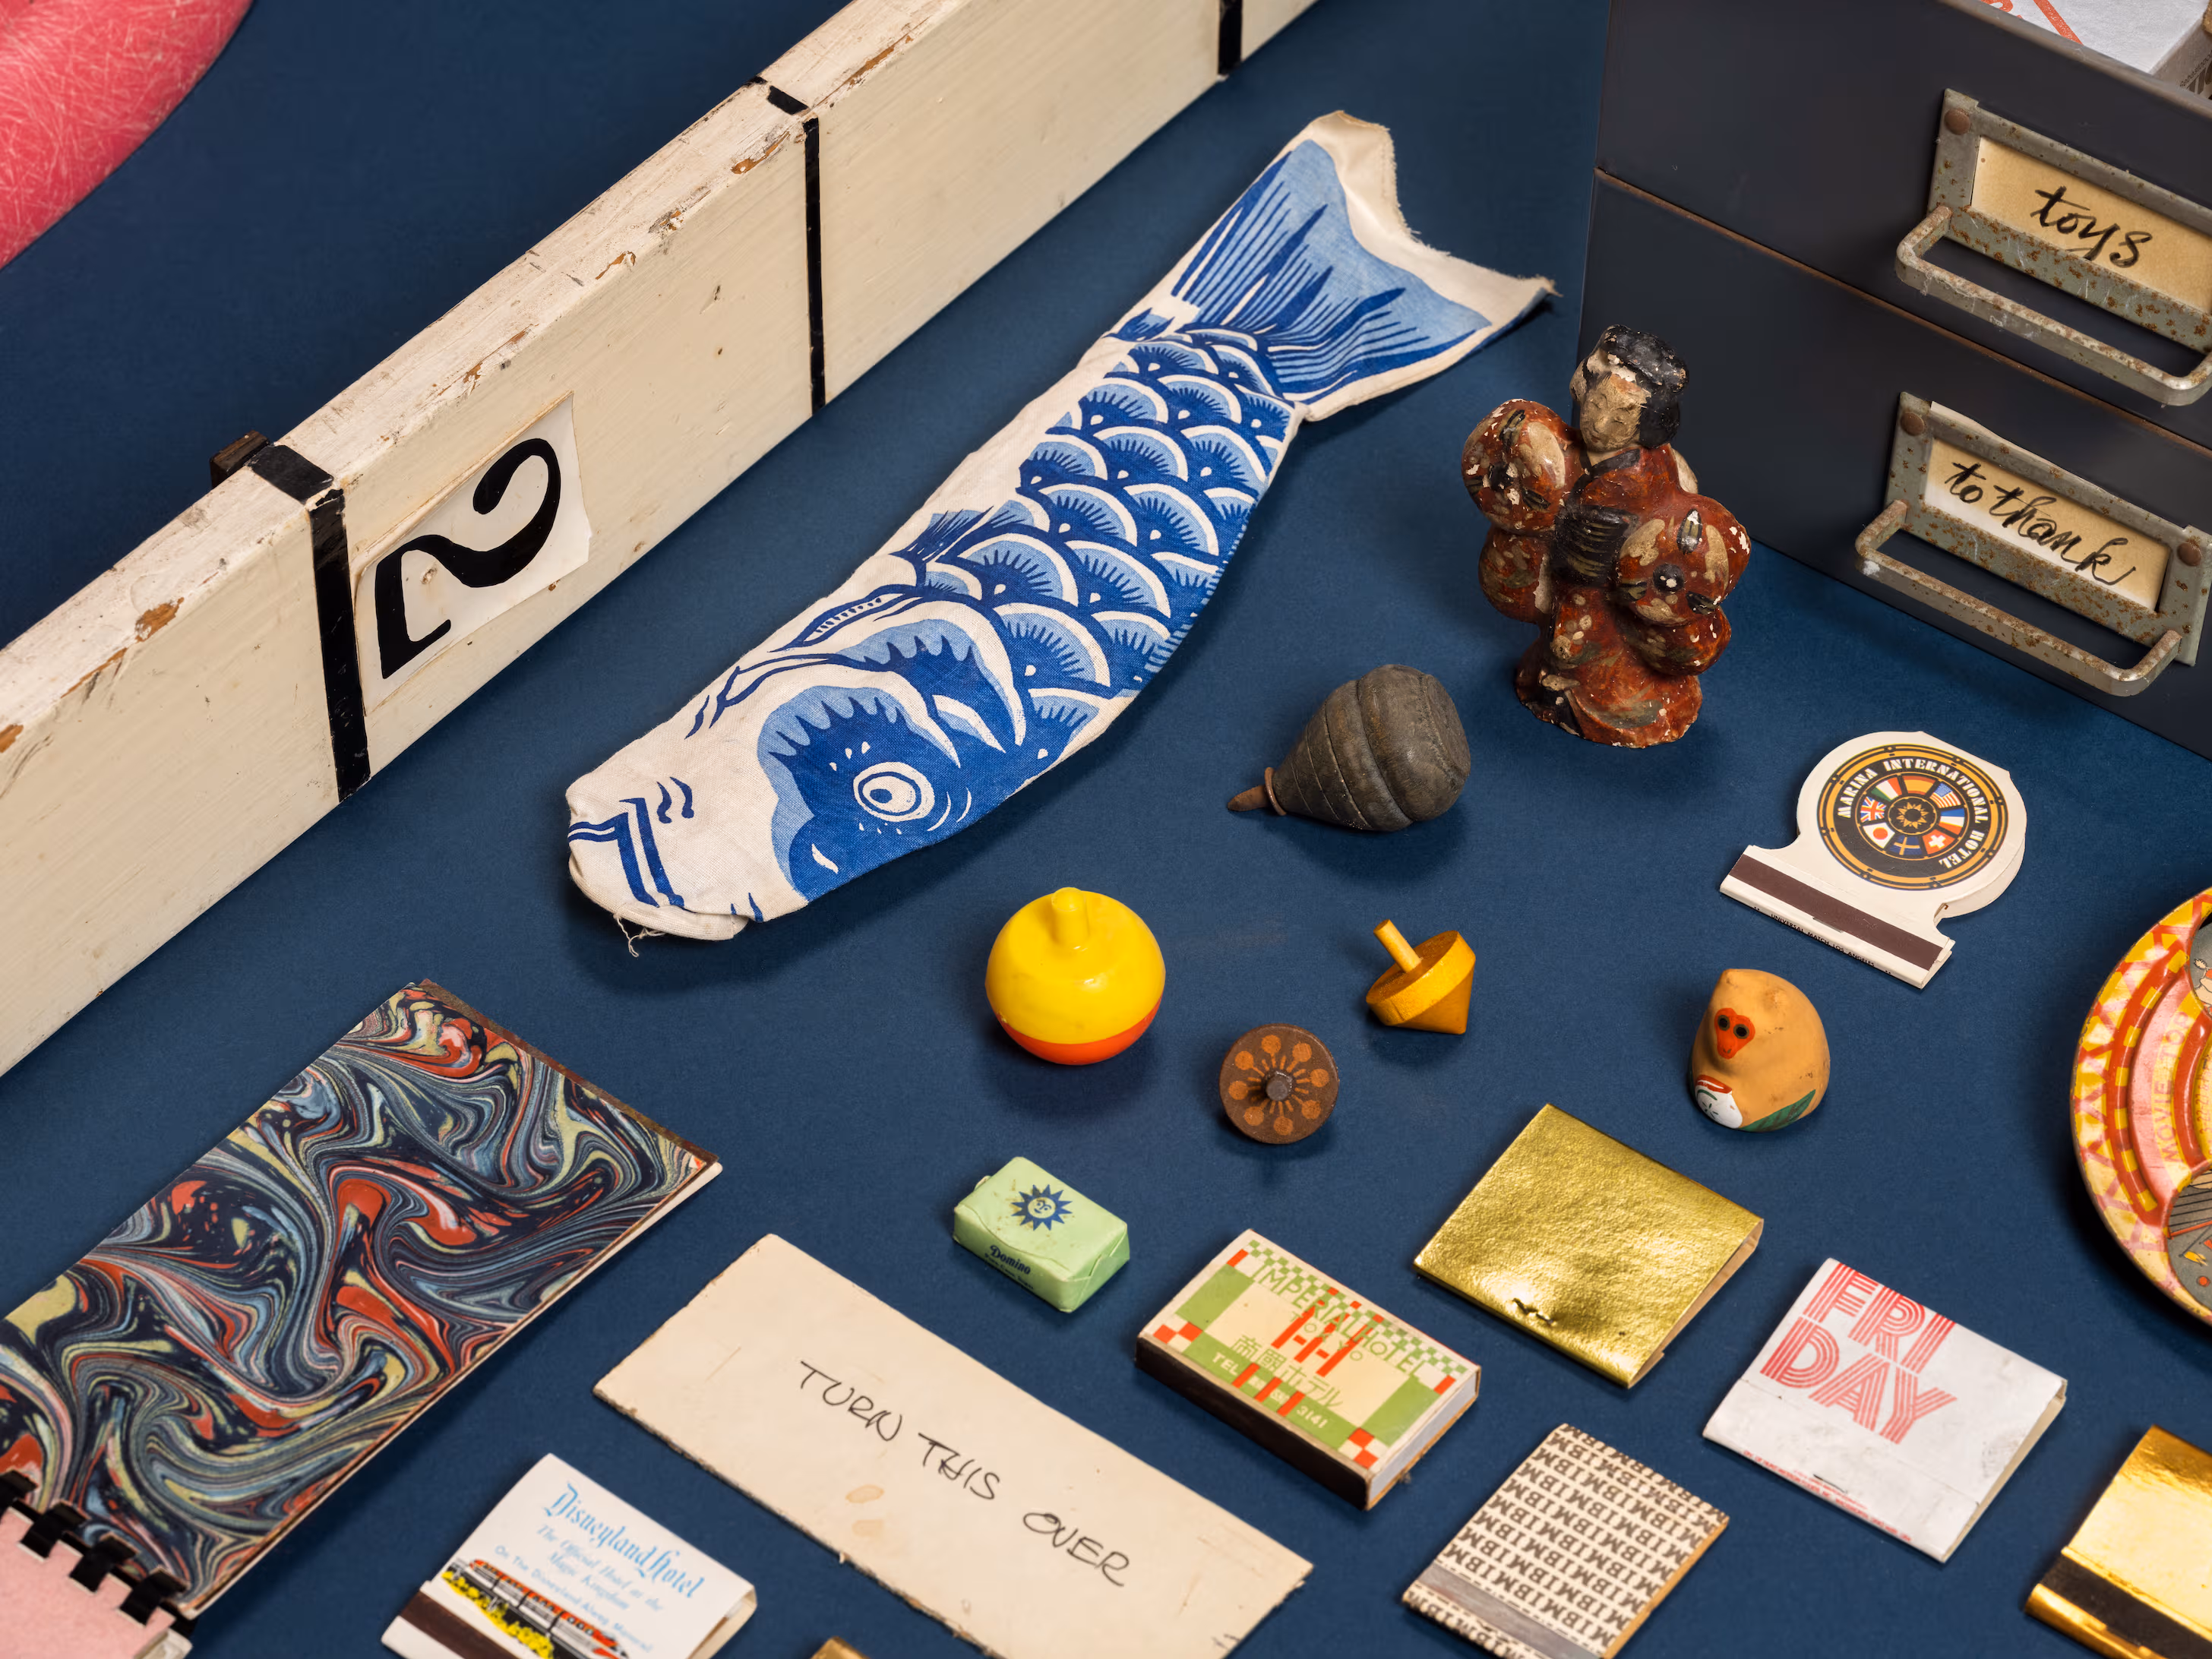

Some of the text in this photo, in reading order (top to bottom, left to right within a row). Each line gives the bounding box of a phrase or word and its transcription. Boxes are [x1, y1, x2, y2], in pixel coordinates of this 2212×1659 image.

[2030, 186, 2153, 268] toys
[374, 438, 561, 679] 2
[1945, 463, 2136, 585] to thank
[1838, 758, 1989, 868] MARINA INTERNATIONAL HOTEL
[1771, 913, 1804, 934] UNIVERSAL
[1833, 943, 1844, 953] LOS
[1848, 951, 1875, 967] ANGELES
[2154, 1080, 2184, 1163] MOVIE
[990, 1244, 1031, 1275] Domino
[1212, 1351, 1240, 1376] TEL
[1231, 1335, 1344, 1410] 帝國ホテル
[1252, 1262, 1426, 1379] IMPERIAL HOTEL
[1802, 1262, 1956, 1374] FRI
[1296, 1406, 1329, 1429] 3141
[1759, 1316, 1958, 1444] DAY
[801, 1360, 1130, 1587] TURN THIS OVER
[543, 1482, 705, 1599] Disneyland Hotel
